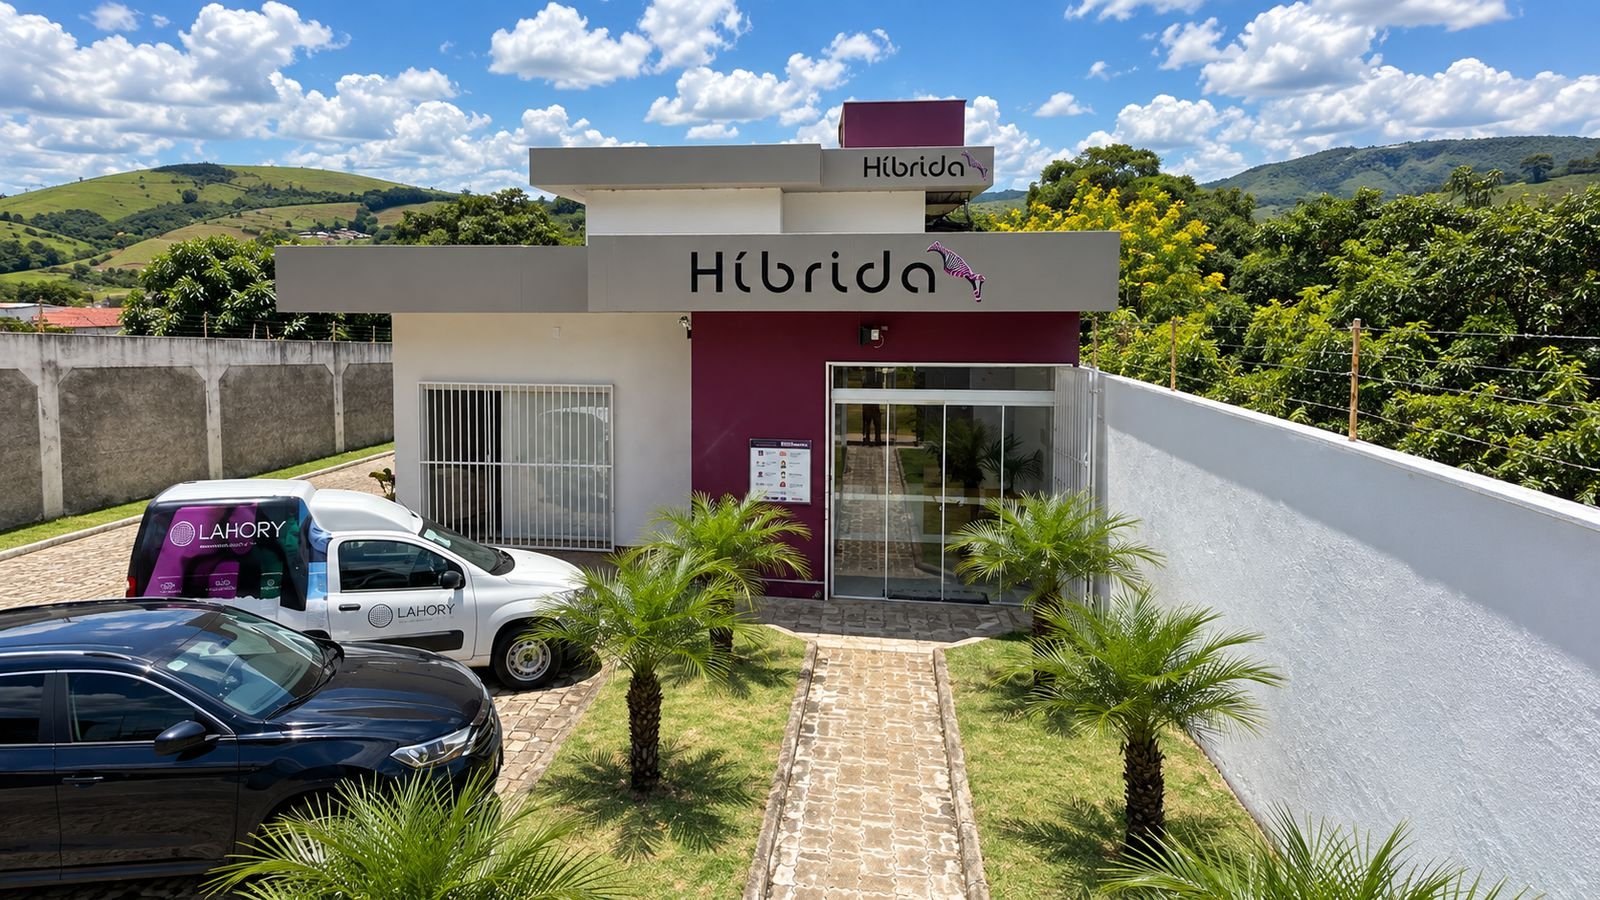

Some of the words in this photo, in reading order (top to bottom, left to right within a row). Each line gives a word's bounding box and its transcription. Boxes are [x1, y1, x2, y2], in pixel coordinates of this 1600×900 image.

[863, 155, 964, 177] Híbrida
[690, 250, 936, 293] Híbrida
[199, 520, 286, 540] LAHORY
[397, 603, 455, 618] LAHORY
